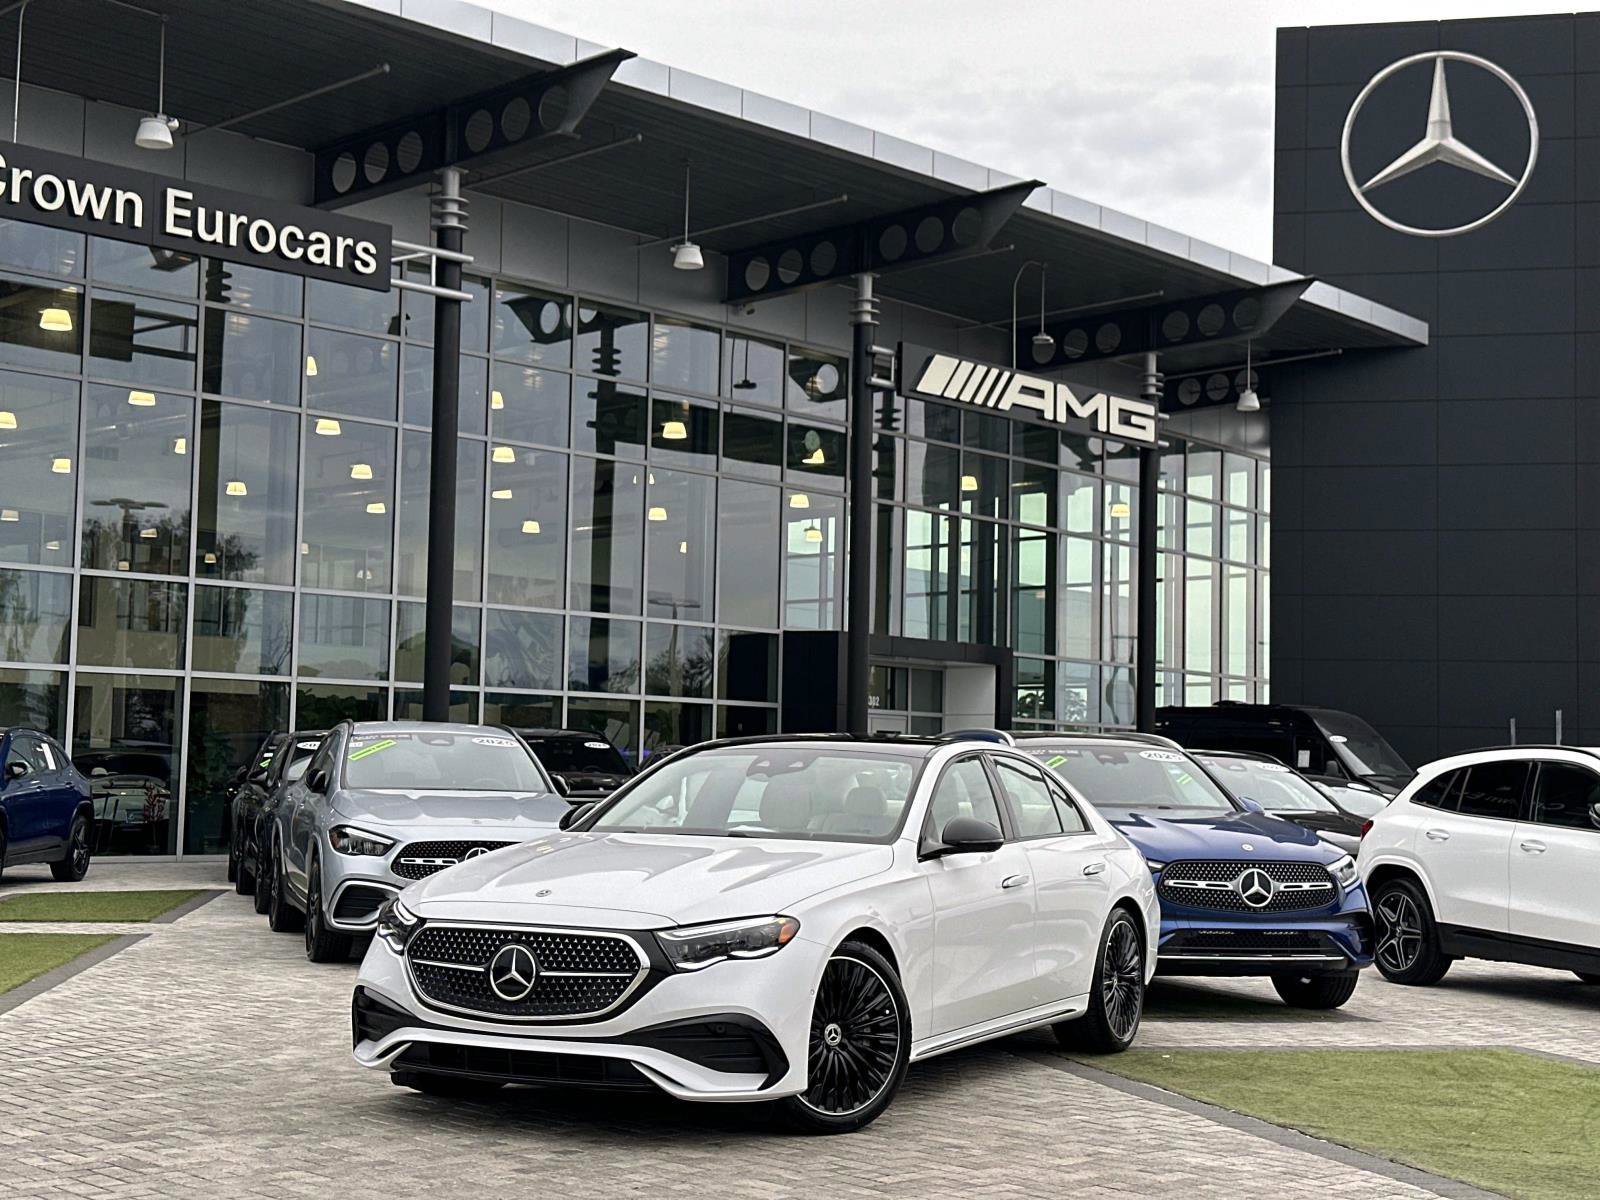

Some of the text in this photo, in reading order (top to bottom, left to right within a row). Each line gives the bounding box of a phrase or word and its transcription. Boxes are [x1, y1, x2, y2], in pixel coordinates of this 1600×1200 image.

[0, 154, 377, 275] rown Eurocars
[998, 372, 1156, 443] AMG
